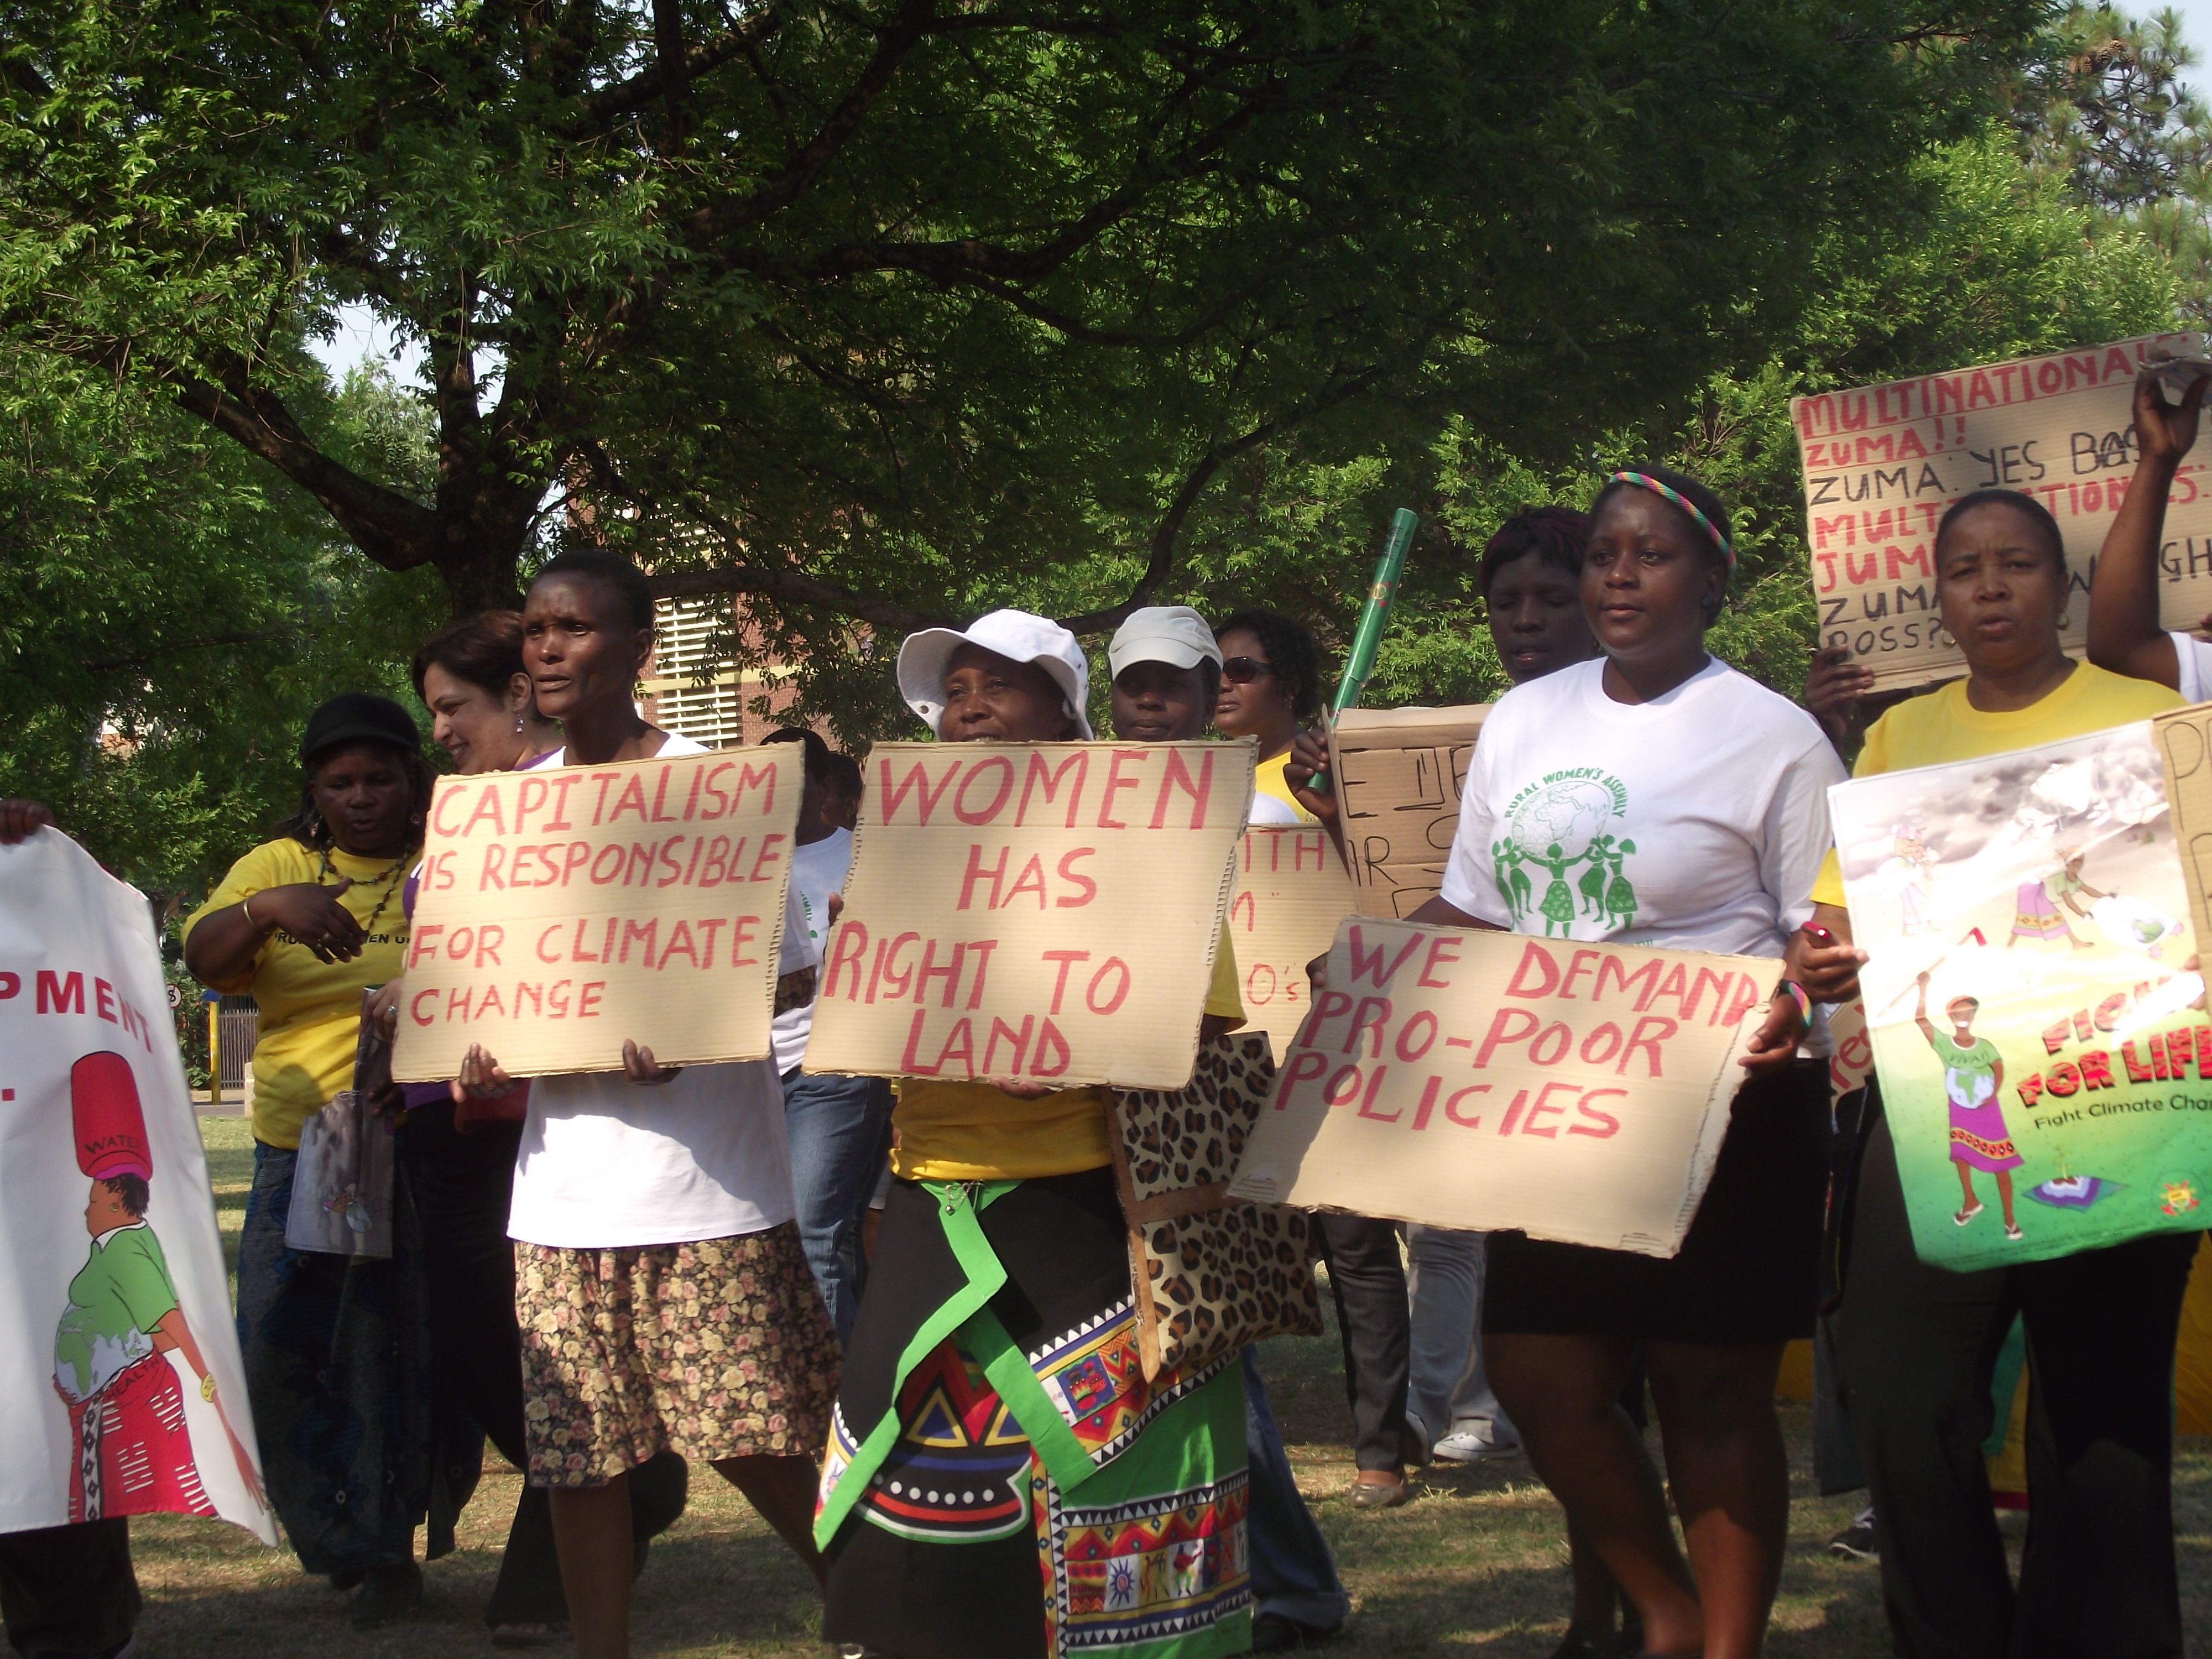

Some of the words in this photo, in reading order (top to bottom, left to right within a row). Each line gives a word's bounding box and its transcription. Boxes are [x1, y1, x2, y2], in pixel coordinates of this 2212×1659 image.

[1806, 416, 1966, 467] ZUMA!!
[1809, 455, 1959, 507] ZUMA:
[1969, 440, 2045, 487] YES
[433, 761, 778, 838] CAPITALISM
[880, 746, 1215, 831] WOMEN
[1505, 782, 1540, 818] RURAL
[1542, 767, 1605, 785] WOMEN'S
[422, 850, 458, 892] IS
[479, 833, 787, 891] RESPONSIBLE
[957, 844, 1098, 911] HAS
[1244, 828, 1324, 873] ITH
[276, 932, 304, 945] RU
[366, 933, 390, 945] EN
[394, 936, 410, 945] U
[408, 924, 505, 971] FOR
[536, 915, 761, 972] CLIMATE
[823, 920, 998, 1011] RIGHT
[1042, 949, 1131, 1015] TO
[410, 979, 606, 1027] CHANGE
[1246, 961, 1301, 1006] O's
[1348, 924, 1463, 989] WE
[1504, 940, 1759, 1028] DEMAND
[901, 1008, 1072, 1079] LAND
[1298, 990, 1678, 1078] PRO-POOR
[2042, 975, 2173, 1056] FIG
[1275, 1051, 1628, 1140] POLICIES
[2017, 1050, 2116, 1109] FOR
[2034, 1109, 2084, 1130] Fight
[2088, 1097, 2163, 1118] Climate
